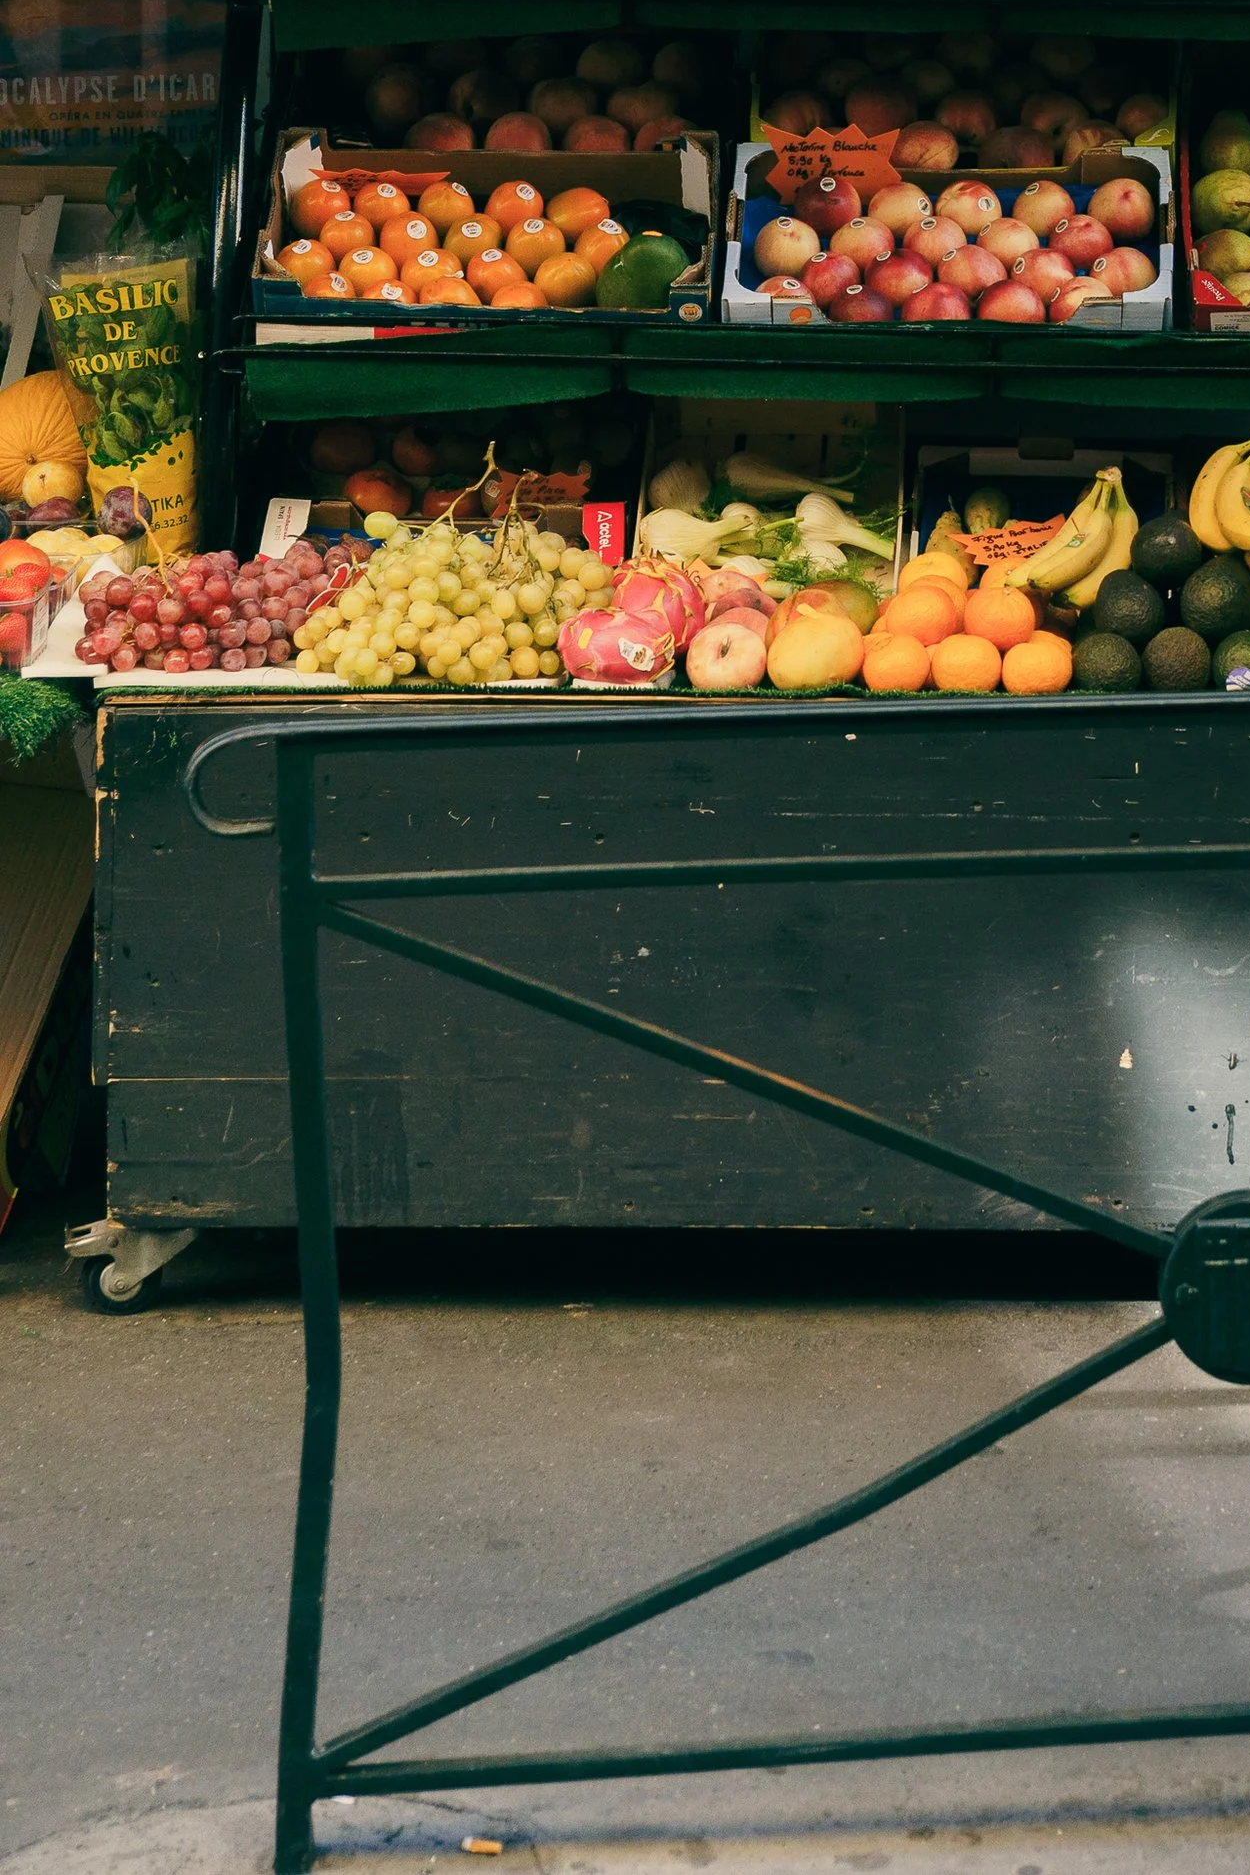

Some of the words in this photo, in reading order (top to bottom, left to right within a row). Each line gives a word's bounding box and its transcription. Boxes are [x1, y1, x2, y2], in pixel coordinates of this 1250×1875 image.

[0, 75, 120, 106] OCALYPSE
[133, 72, 217, 102] D'ICAR
[0, 129, 71, 148] MINIQUE
[48, 277, 178, 322] BASILIC
[103, 320, 139, 342] DE
[66, 343, 181, 378] PROVENCE
[150, 493, 184, 513] TIKA
[149, 514, 189, 532] 6.32.32
